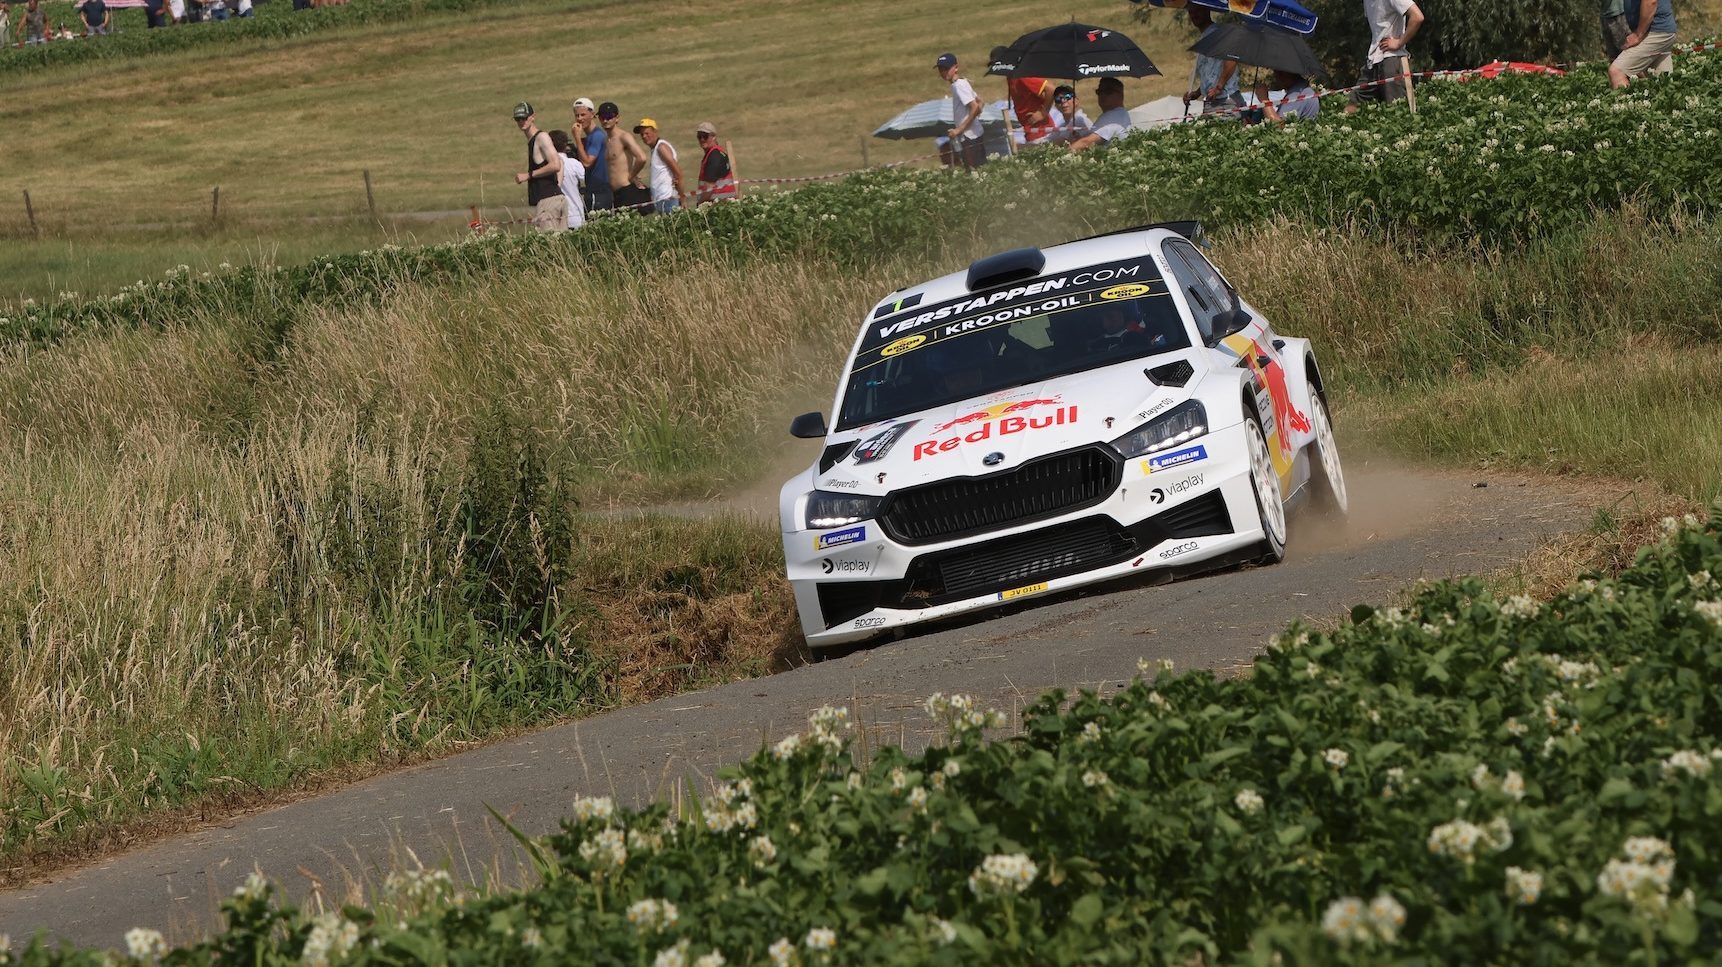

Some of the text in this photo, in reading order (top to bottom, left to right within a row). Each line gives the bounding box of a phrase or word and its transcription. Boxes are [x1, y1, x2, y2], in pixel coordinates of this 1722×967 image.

[1078, 64, 1130, 75] TaylorMade
[1107, 287, 1143, 296] KROON
[880, 265, 1140, 338] VERSTAPPEN.COM
[945, 296, 1081, 335] KROON-OIL
[913, 422, 991, 461] Red
[999, 405, 1078, 435] Bull
[1161, 450, 1200, 466] MICHELIN
[1165, 473, 1204, 496] viaplay
[827, 531, 860, 544] MICHELIN
[1159, 541, 1198, 558] sparco
[835, 559, 870, 573] viaplay
[854, 617, 886, 627] sparco
